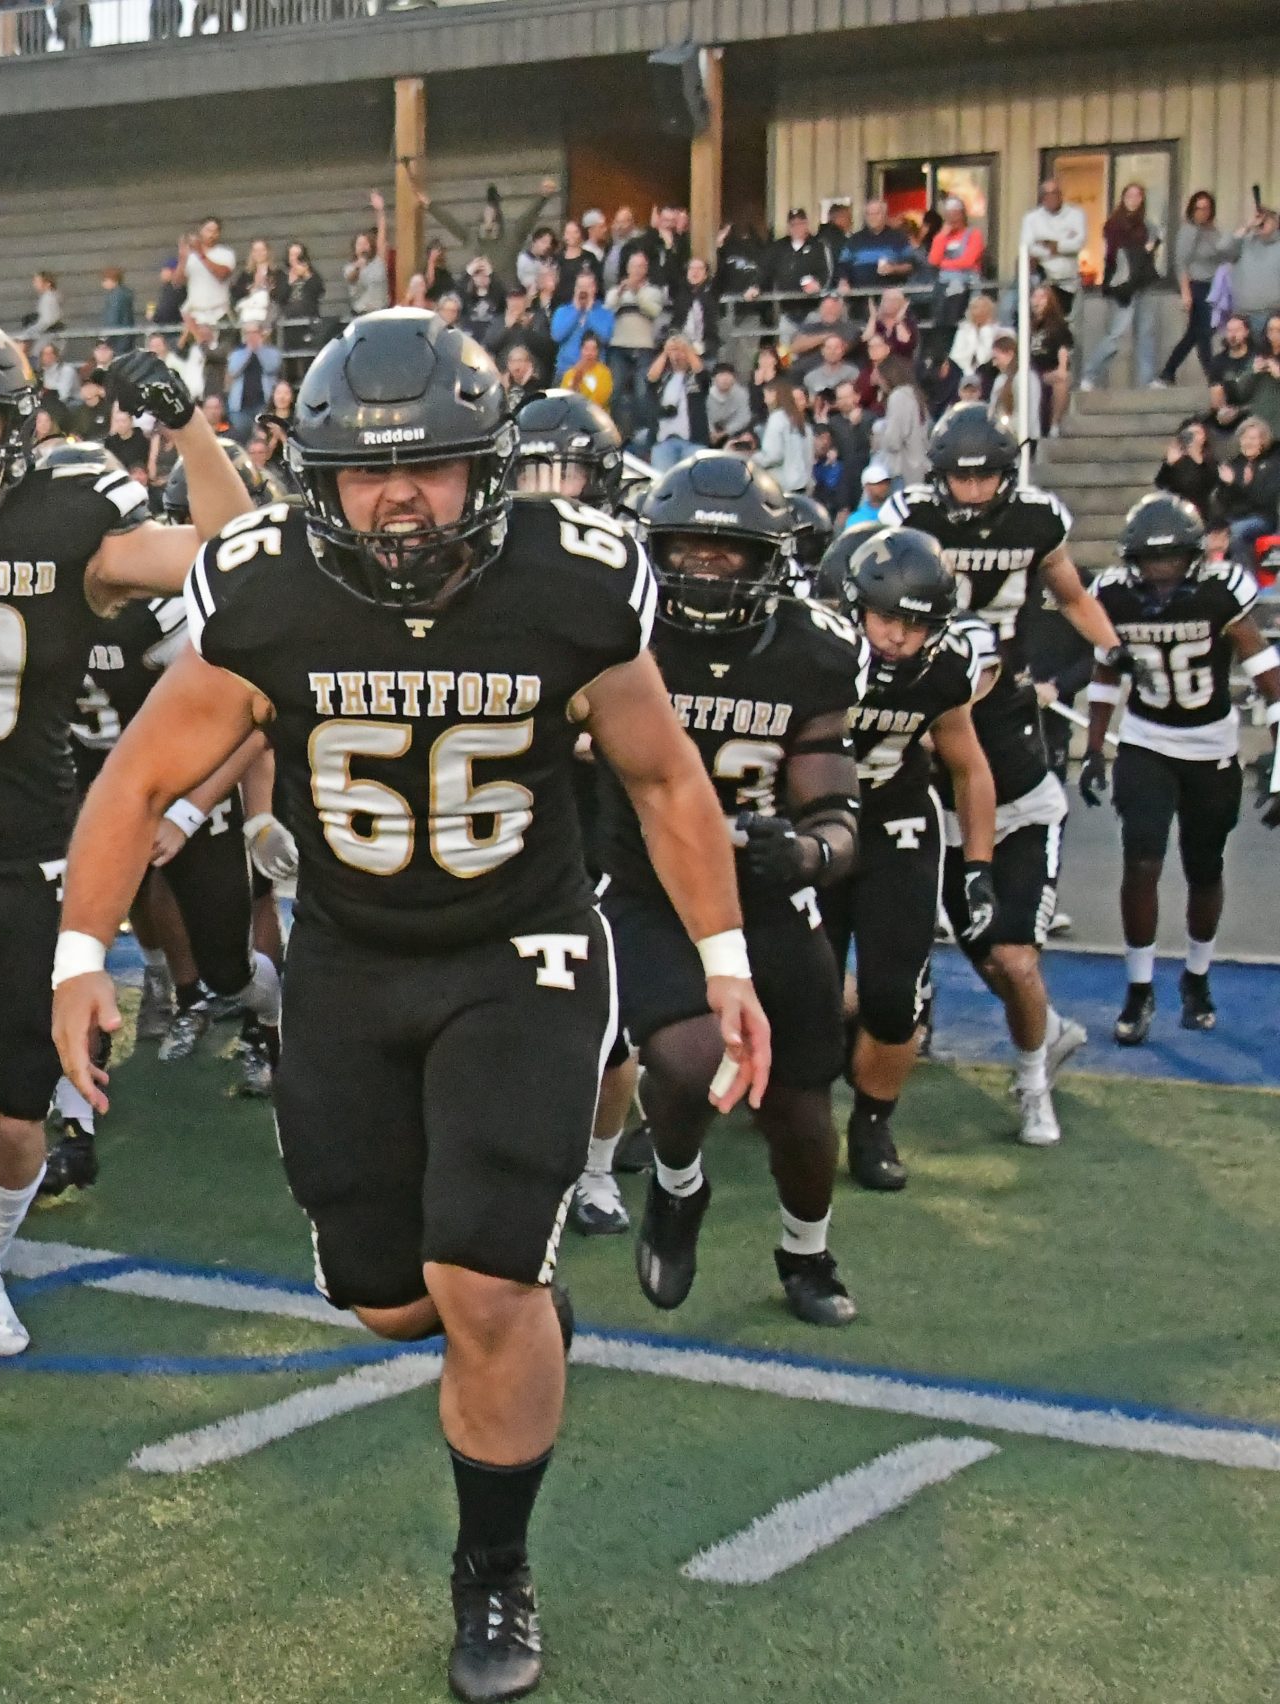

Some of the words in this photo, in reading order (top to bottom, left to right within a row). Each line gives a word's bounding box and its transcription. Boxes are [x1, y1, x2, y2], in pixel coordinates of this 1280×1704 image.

[364, 427, 425, 445] Riddell
[405, 618, 433, 638] T
[309, 671, 542, 717] THETFORD
[670, 693, 793, 736] ETFORD
[308, 719, 534, 880] 66
[883, 816, 927, 849] T
[511, 932, 590, 991] T
